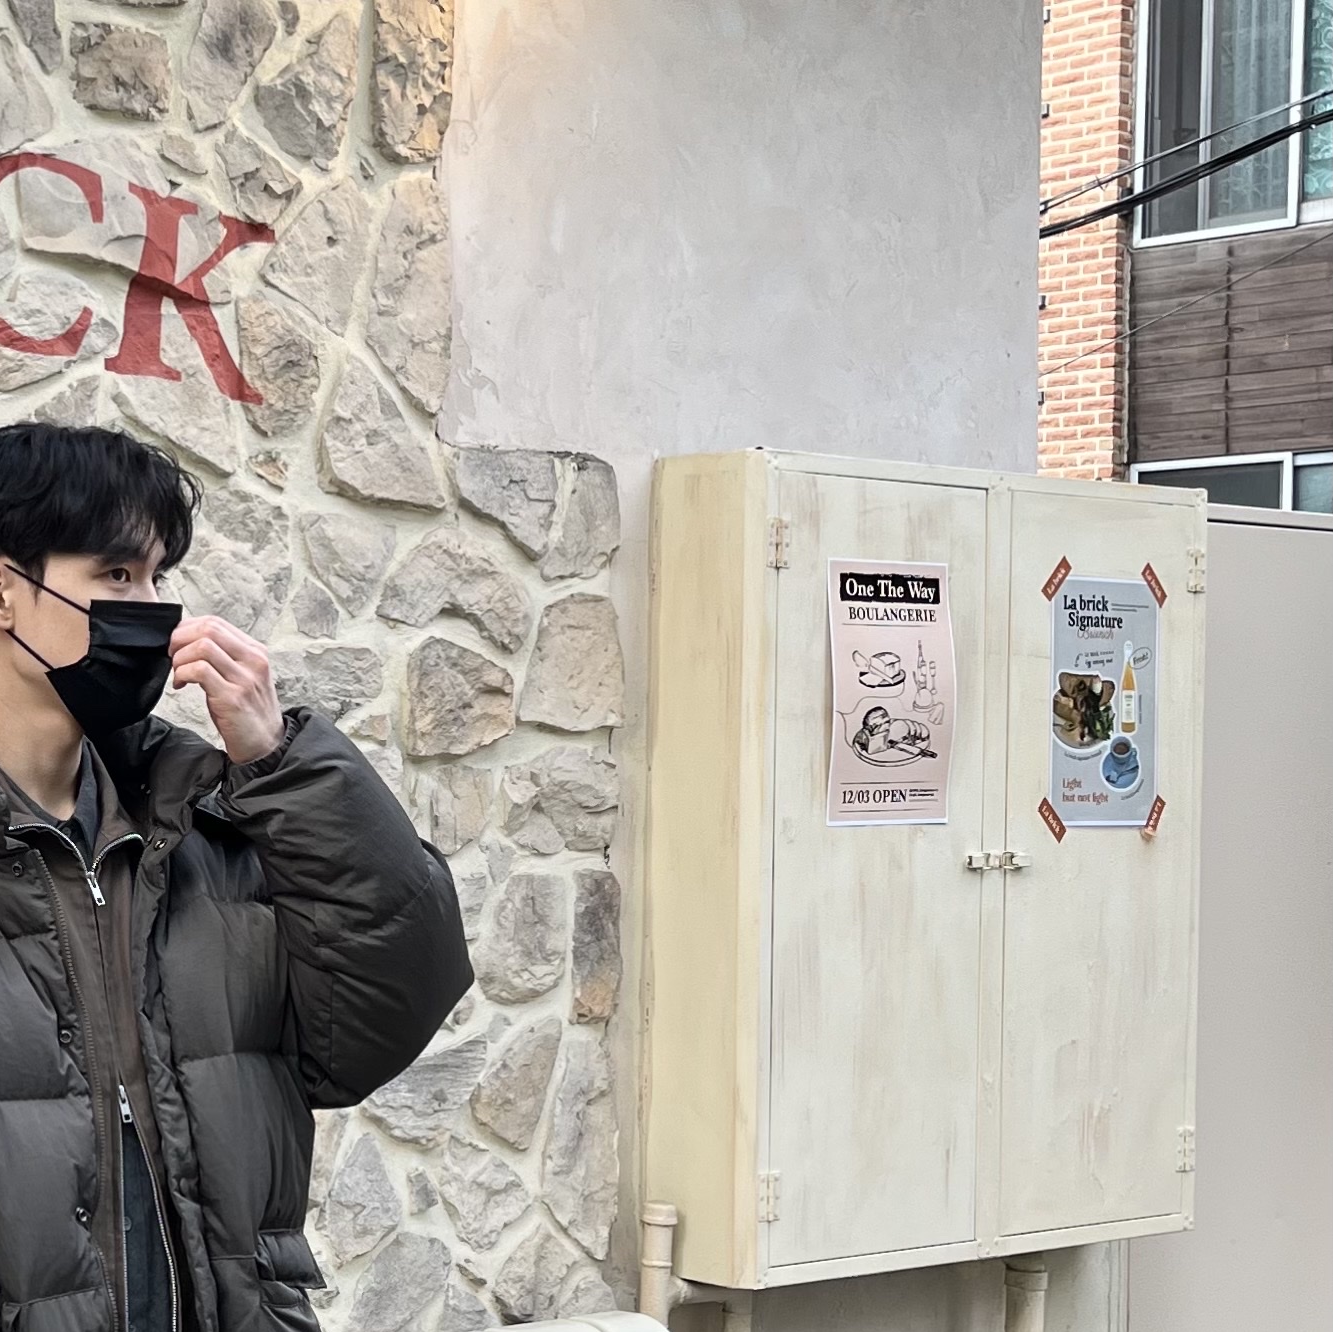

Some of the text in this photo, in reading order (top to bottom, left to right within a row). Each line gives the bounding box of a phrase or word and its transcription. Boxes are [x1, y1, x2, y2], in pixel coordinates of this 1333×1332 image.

[845, 578, 936, 602] One The Way
[1063, 594, 1109, 612] La brick
[848, 606, 937, 622] BOULANGERIE
[1068, 610, 1123, 631] Signature
[1062, 777, 1082, 791] Light
[842, 788, 907, 804] 12/03 OPEN
[1062, 792, 1109, 805] but not light
